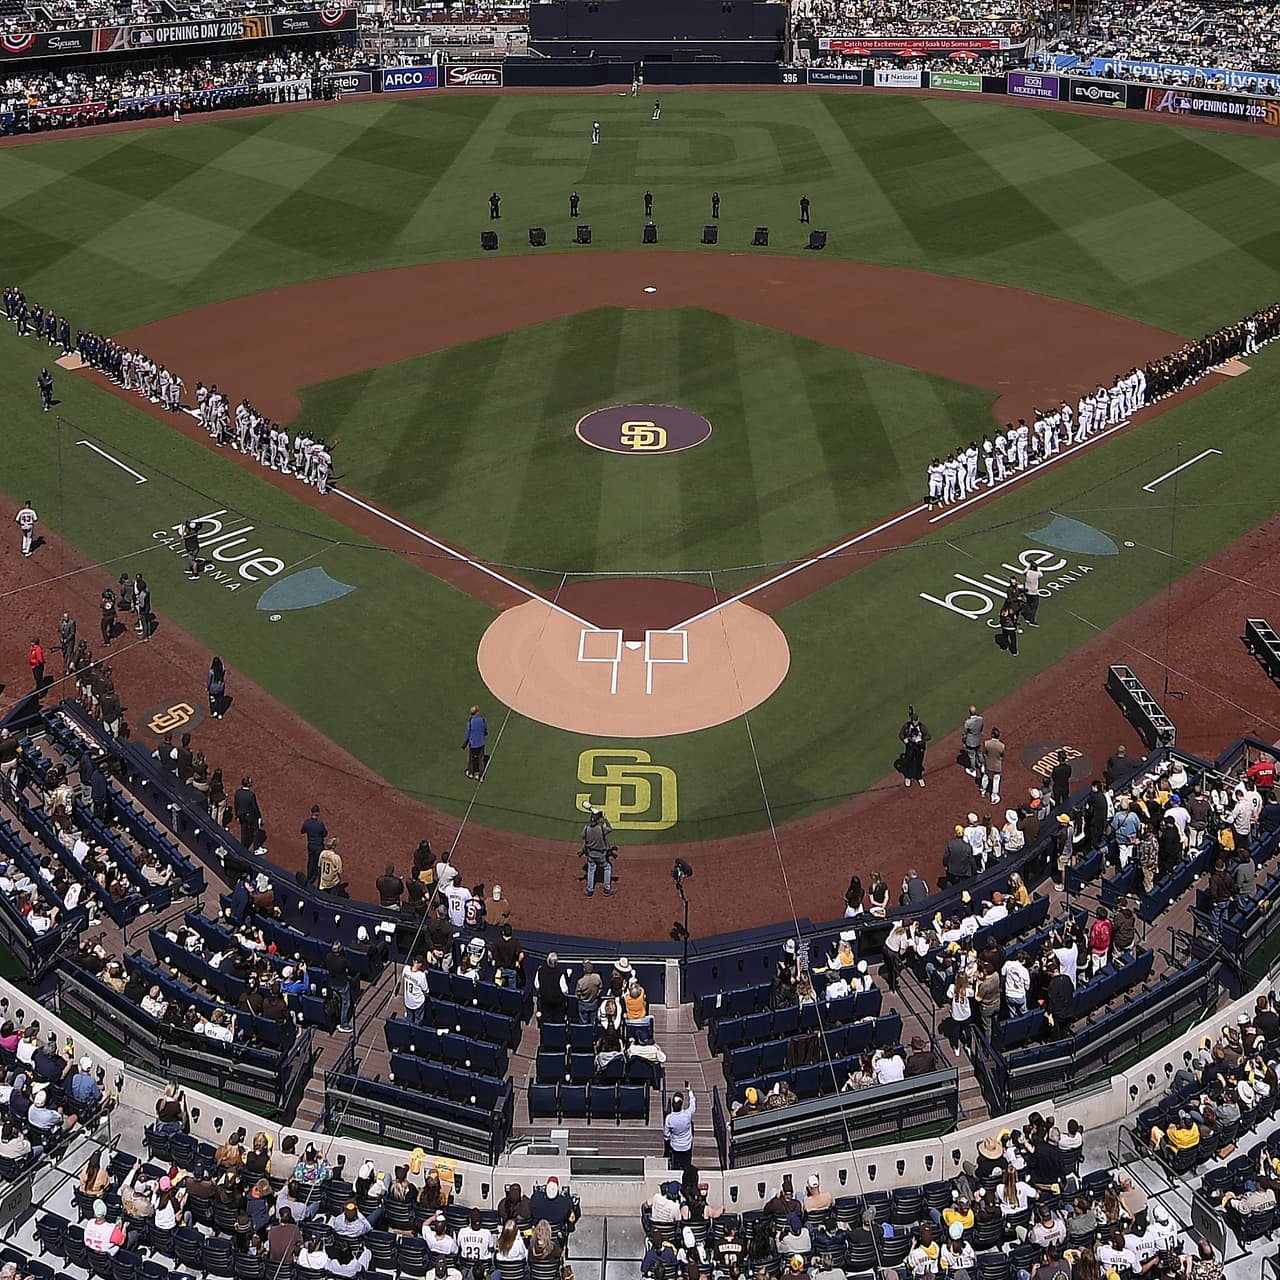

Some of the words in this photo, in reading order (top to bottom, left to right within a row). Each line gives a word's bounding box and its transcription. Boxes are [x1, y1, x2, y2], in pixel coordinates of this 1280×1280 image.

[282, 17, 309, 30] Sycuan
[156, 26, 200, 42] OPENING
[200, 24, 219, 39] DAY
[220, 21, 244, 37] 2025
[47, 36, 81, 50] Sycuan
[941, 41, 950, 49] Up
[334, 76, 359, 87] stelo
[385, 73, 423, 85] ARCO
[450, 68, 497, 84] Sycuan
[783, 73, 798, 83] 396
[890, 73, 918, 81] National
[1014, 86, 1036, 94] NEXEN
[1037, 88, 1053, 97] TIRE
[1192, 99, 1228, 114] OPENING
[1228, 102, 1246, 116] DAY
[1246, 104, 1267, 118] 2025
[620, 420, 667, 451] SD
[172, 509, 286, 581] blue
[147, 702, 195, 734] SD
[575, 748, 678, 831] SD
[322, 861, 331, 874] 13
[451, 899, 461, 911] 12
[465, 1246, 480, 1260] 23
